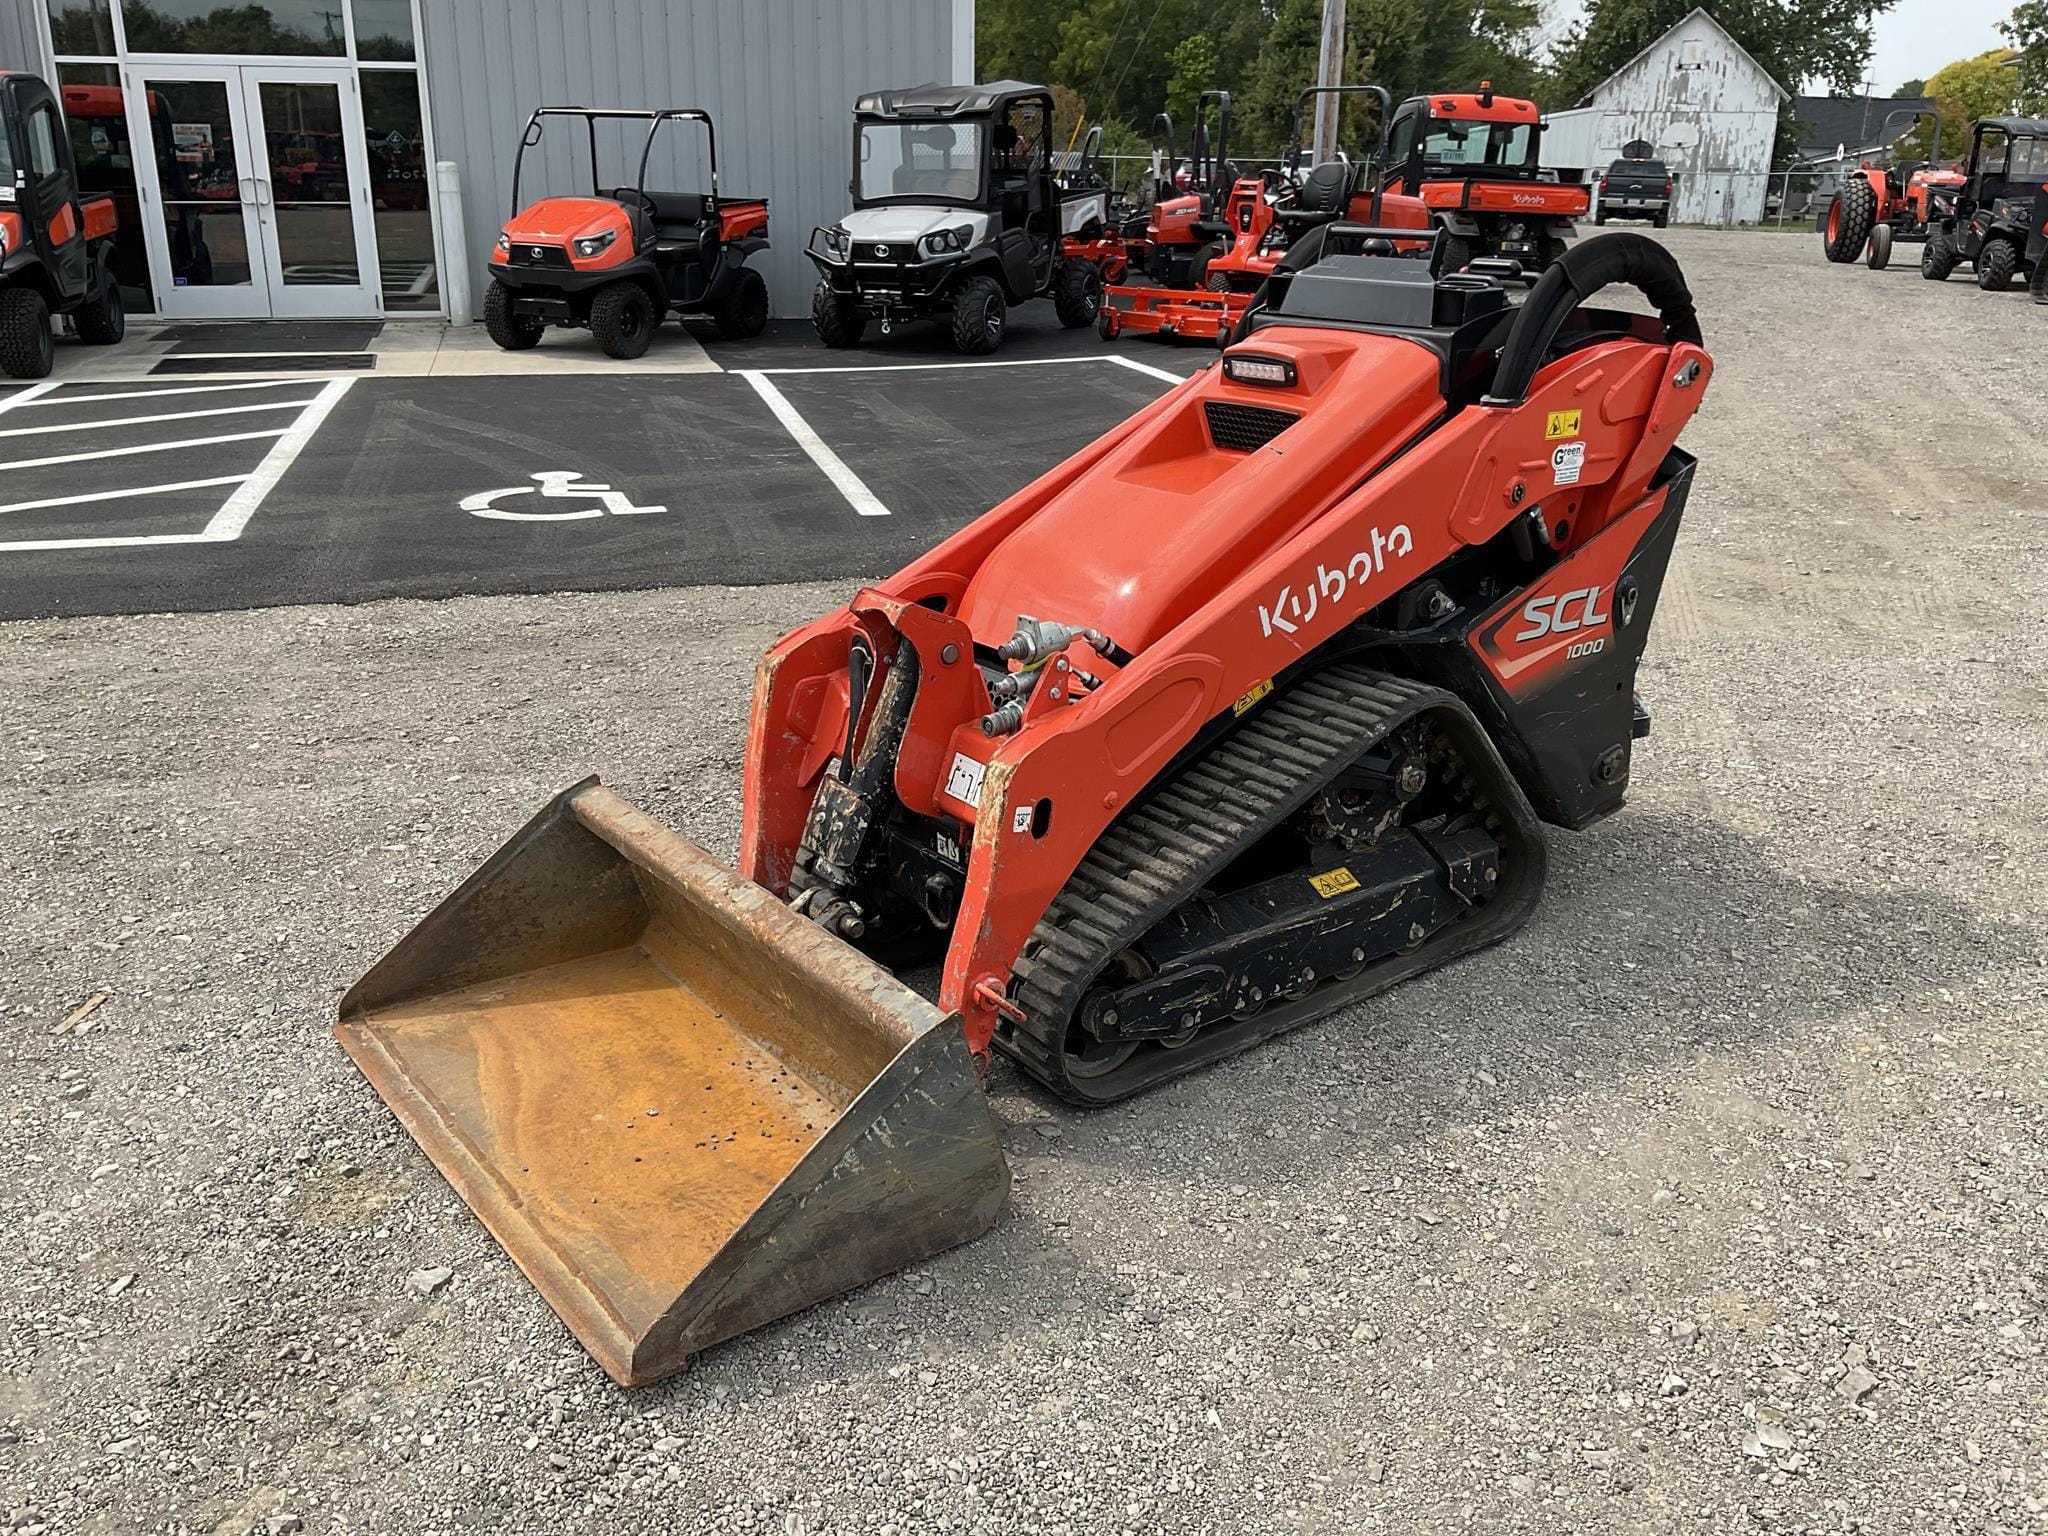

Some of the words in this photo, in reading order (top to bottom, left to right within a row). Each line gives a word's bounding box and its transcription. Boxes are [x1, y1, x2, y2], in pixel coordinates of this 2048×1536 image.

[1513, 194, 1545, 205] Kubota
[1554, 447, 1581, 466] Green
[1258, 524, 1413, 638] Kubota
[1516, 586, 1608, 642] SCL
[1566, 638, 1605, 660] 1000
